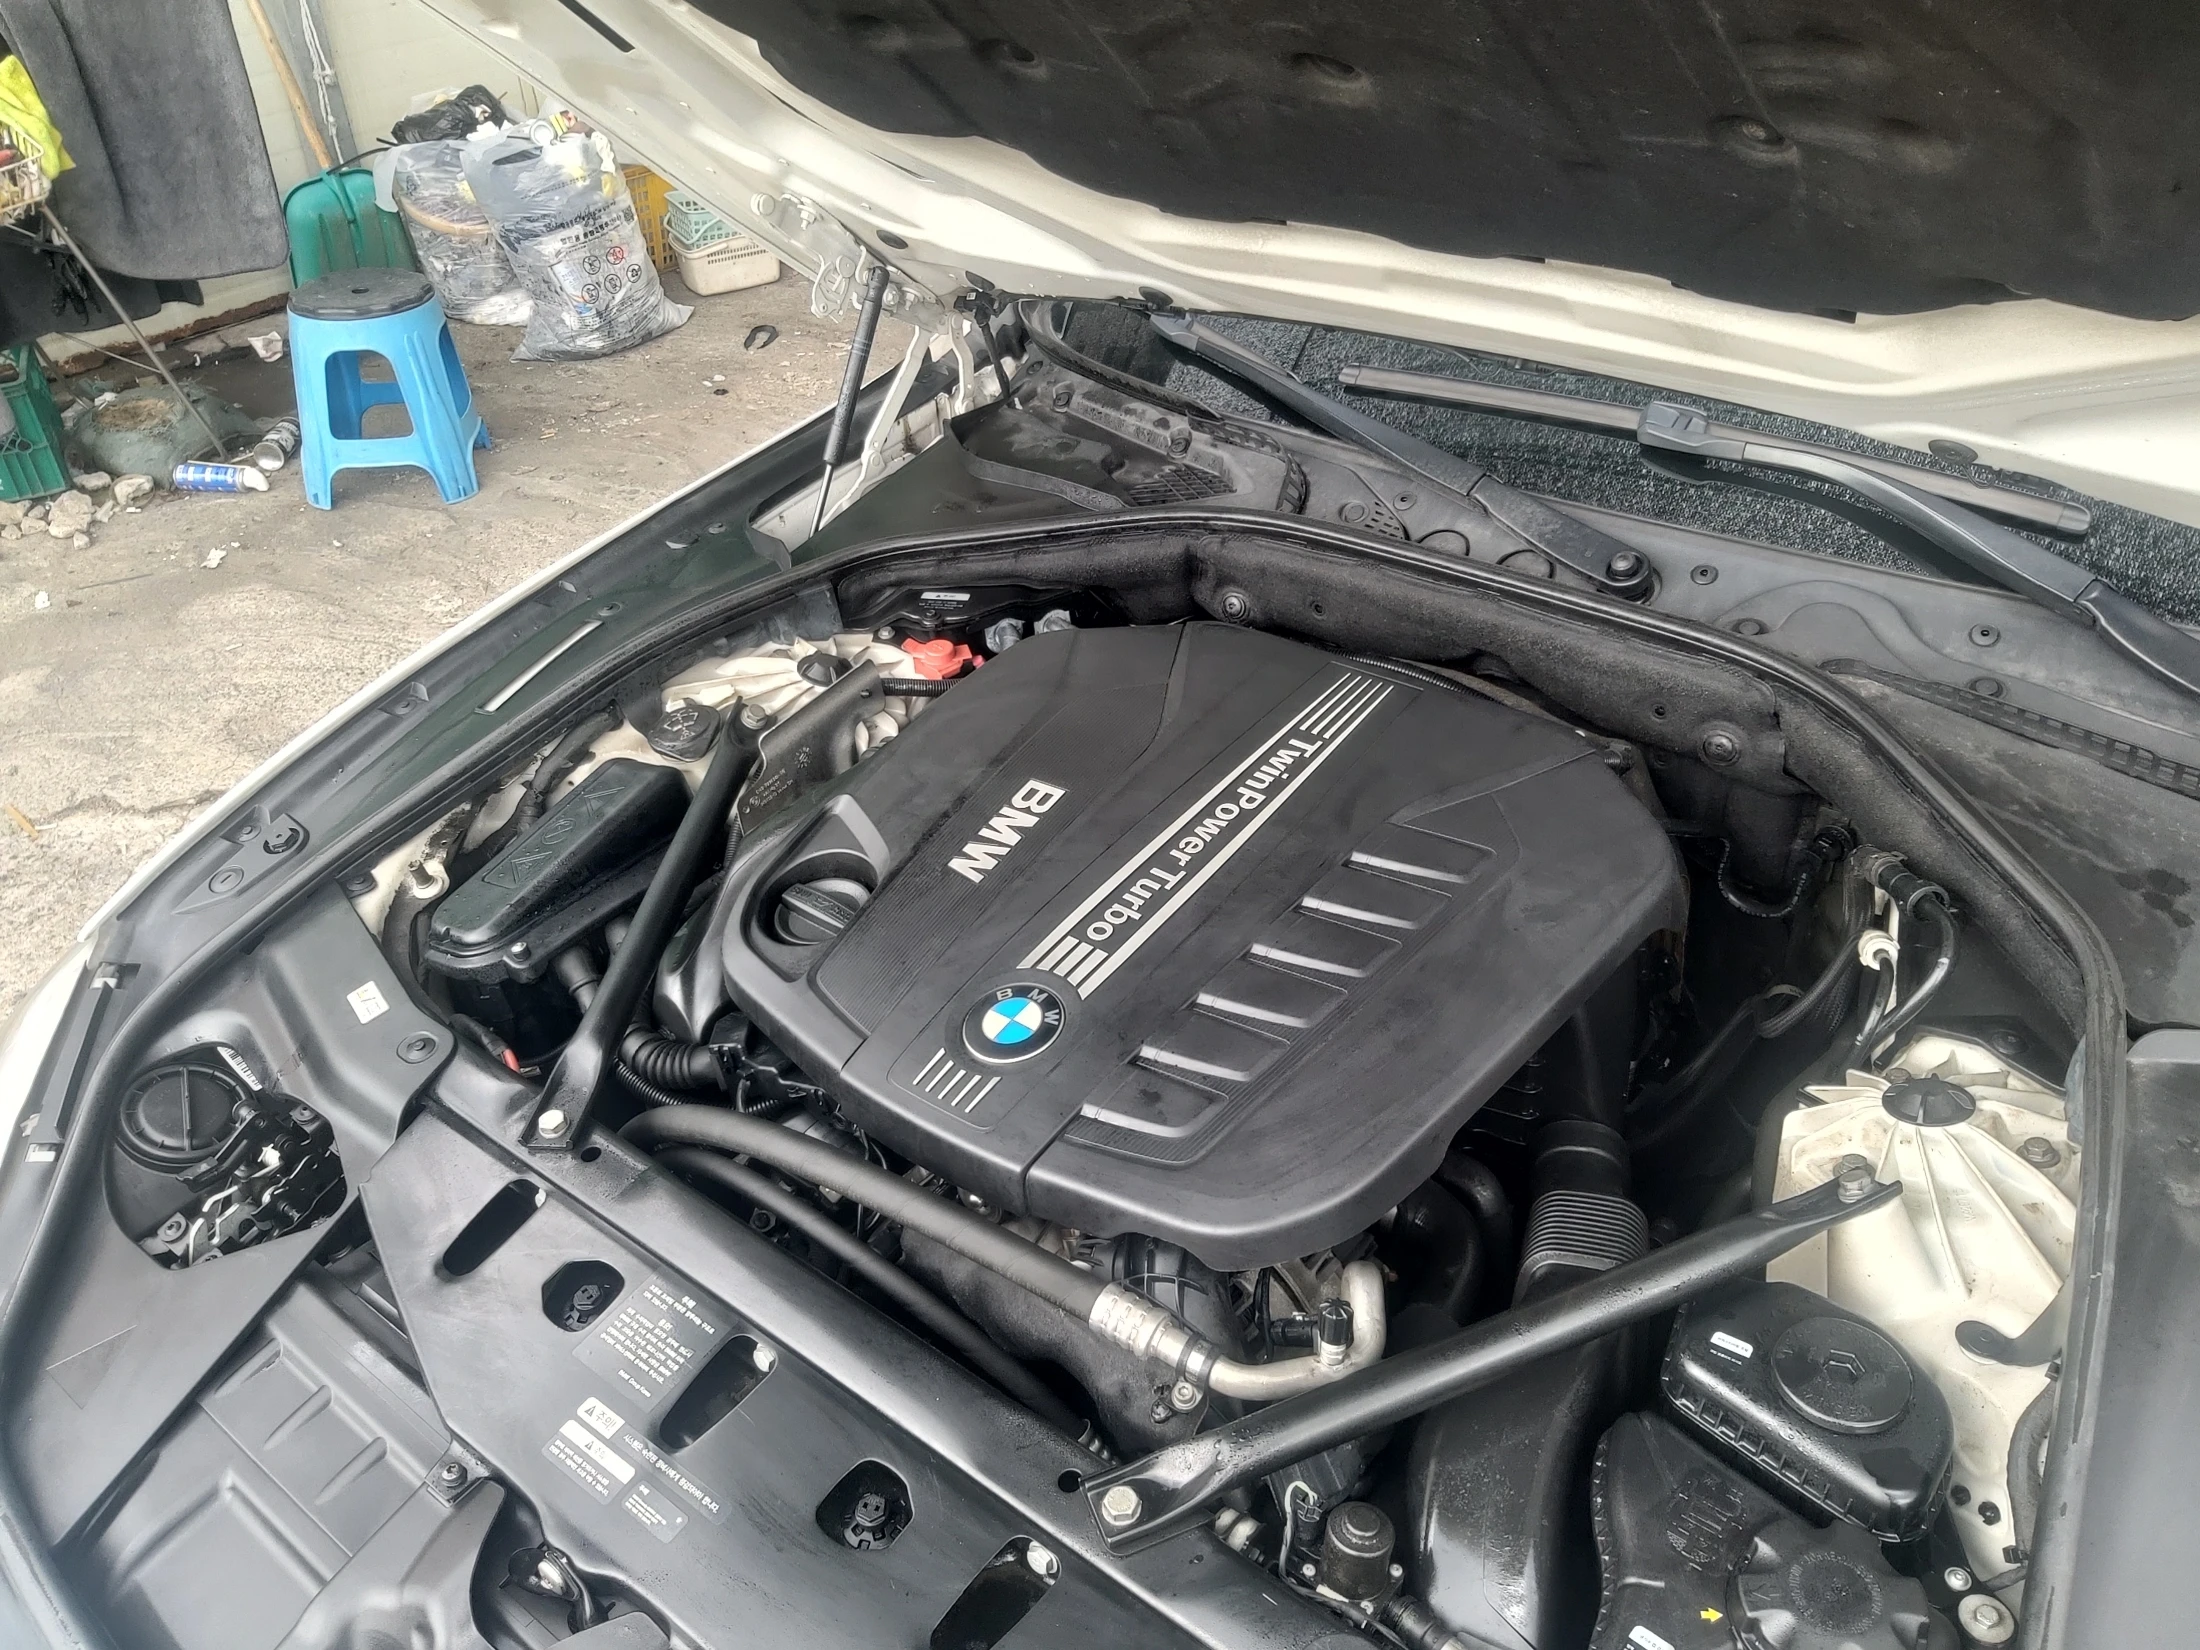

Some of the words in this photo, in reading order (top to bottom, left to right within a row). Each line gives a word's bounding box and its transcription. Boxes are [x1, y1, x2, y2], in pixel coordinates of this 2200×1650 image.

[947, 779, 1066, 883] BMW
[1169, 738, 1323, 867] TwinPower
[1086, 867, 1187, 941] Turbo
[996, 988, 1060, 1026] BMW
[593, 1409, 617, 1432] 주의!
